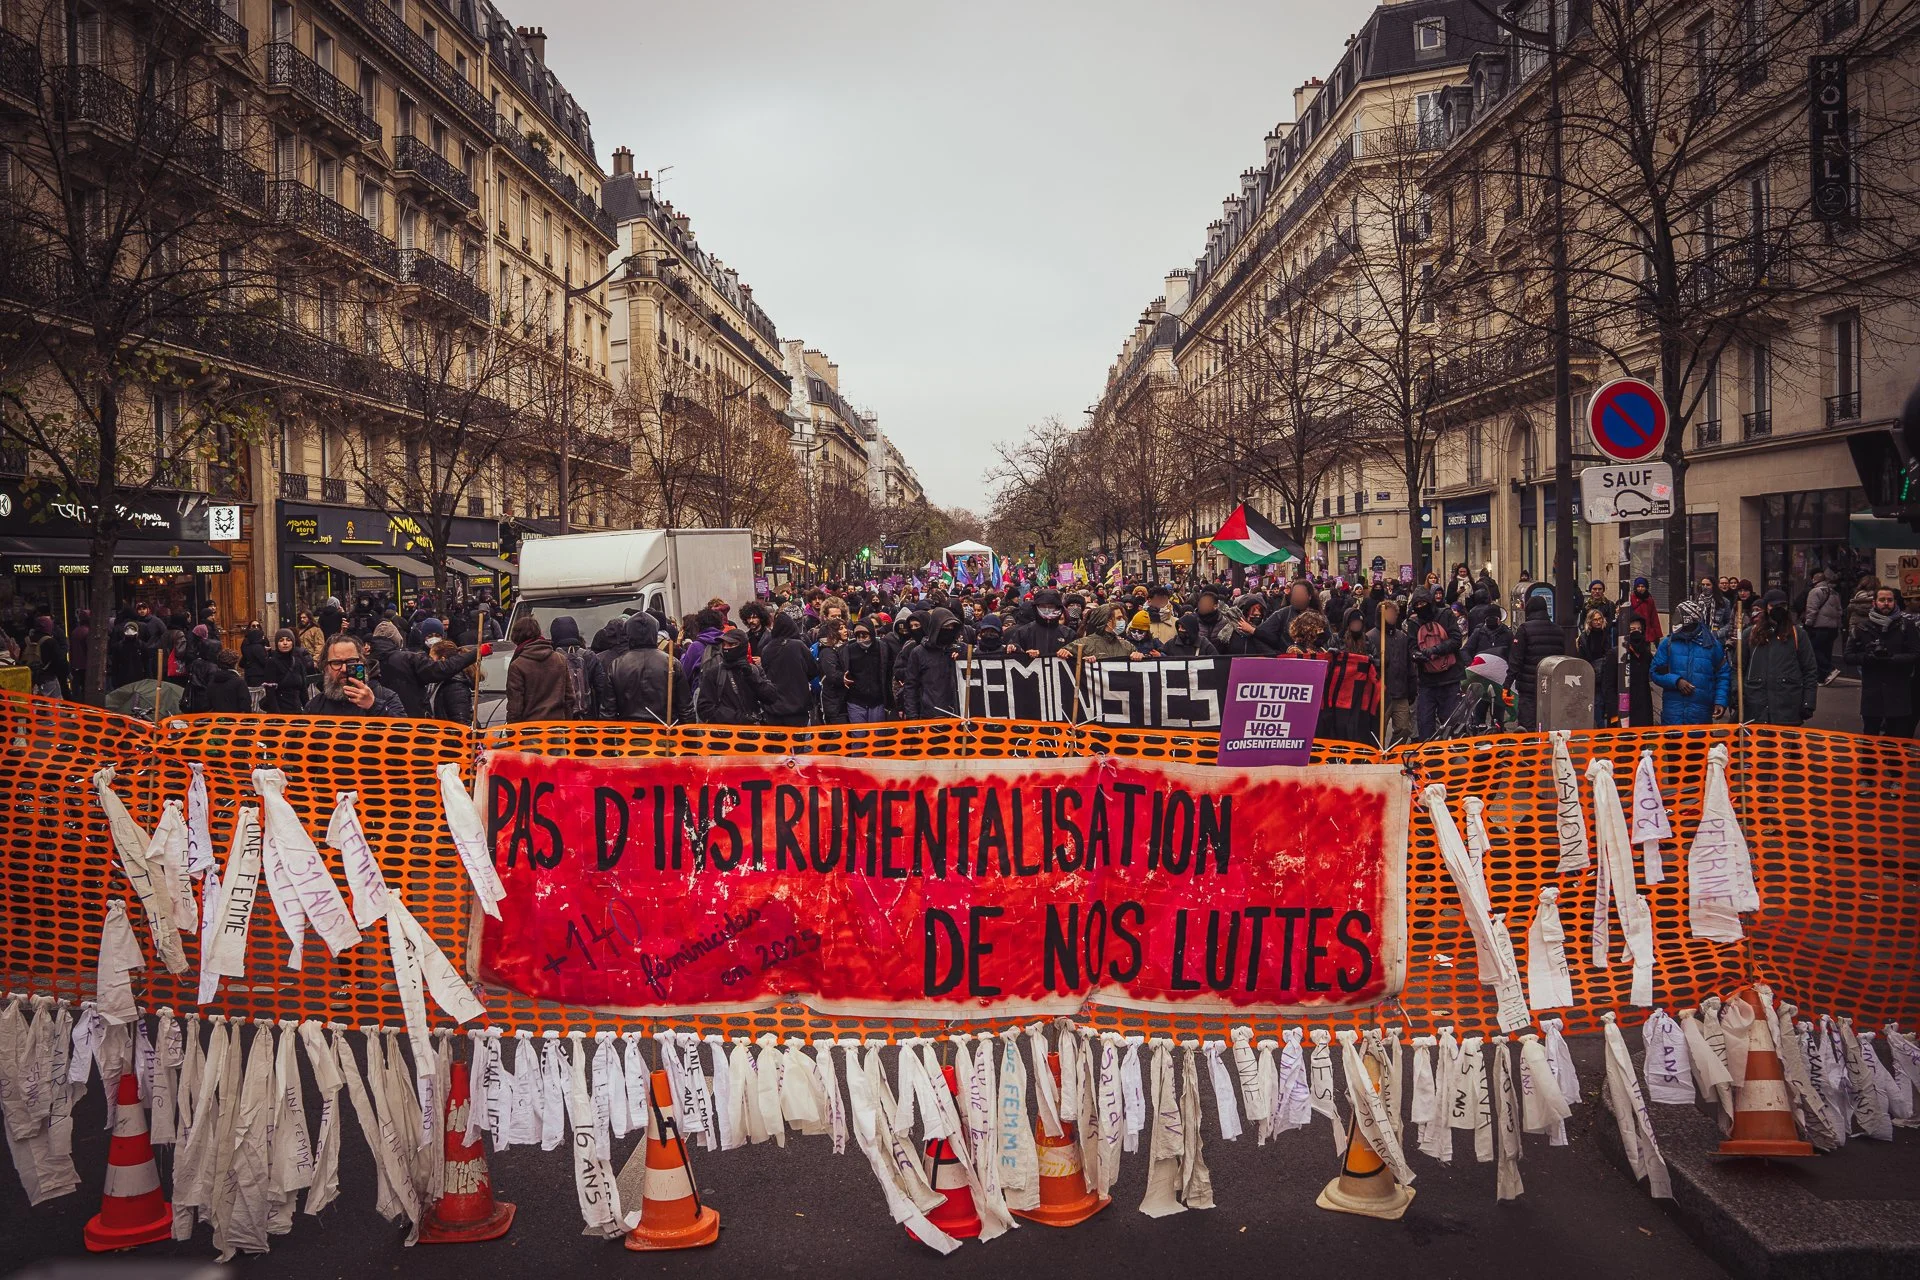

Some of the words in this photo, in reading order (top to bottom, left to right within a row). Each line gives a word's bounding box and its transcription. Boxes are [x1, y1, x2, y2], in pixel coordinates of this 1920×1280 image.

[1820, 61, 1840, 178] HOTEL
[1603, 470, 1652, 488] SAUF
[286, 519, 317, 534] Manga
[296, 527, 315, 536] story
[13, 565, 42, 573] STATUES
[59, 565, 90, 574] FIGURINES
[141, 565, 164, 573] LIBRAIRIE
[164, 565, 184, 573] MANGA
[196, 564, 213, 573] BUBBLE
[213, 564, 224, 573] TEA
[1239, 684, 1310, 701] CULTURE
[1259, 704, 1283, 718] DU
[1226, 739, 1306, 751] CONSENTEMENT
[1248, 723, 1290, 738] VIOL
[242, 823, 262, 859] UNE
[487, 774, 564, 870] PAS
[593, 780, 1233, 881] D'INSTRUMENTALISATION
[1695, 819, 1734, 910] PERRINE
[224, 873, 256, 937] FEMME
[303, 889, 346, 933] ANS
[721, 965, 752, 985] en
[756, 927, 822, 971] 2025
[924, 902, 1002, 997] DE
[1044, 900, 1145, 990] NOS
[1171, 905, 1373, 993] LUTTES
[1663, 1045, 1679, 1084] ANS
[1521, 1074, 1533, 1096] ANS
[684, 1086, 696, 1116] ANS
[1453, 1089, 1466, 1118] ANS
[287, 1087, 301, 1114] UNE
[295, 1122, 312, 1173] FEMME
[423, 1105, 434, 1130] ANS
[1002, 1084, 1019, 1168] FEMME
[1506, 1101, 1514, 1133] ANS
[575, 1125, 596, 1148] 16
[582, 1158, 602, 1205] ANS
